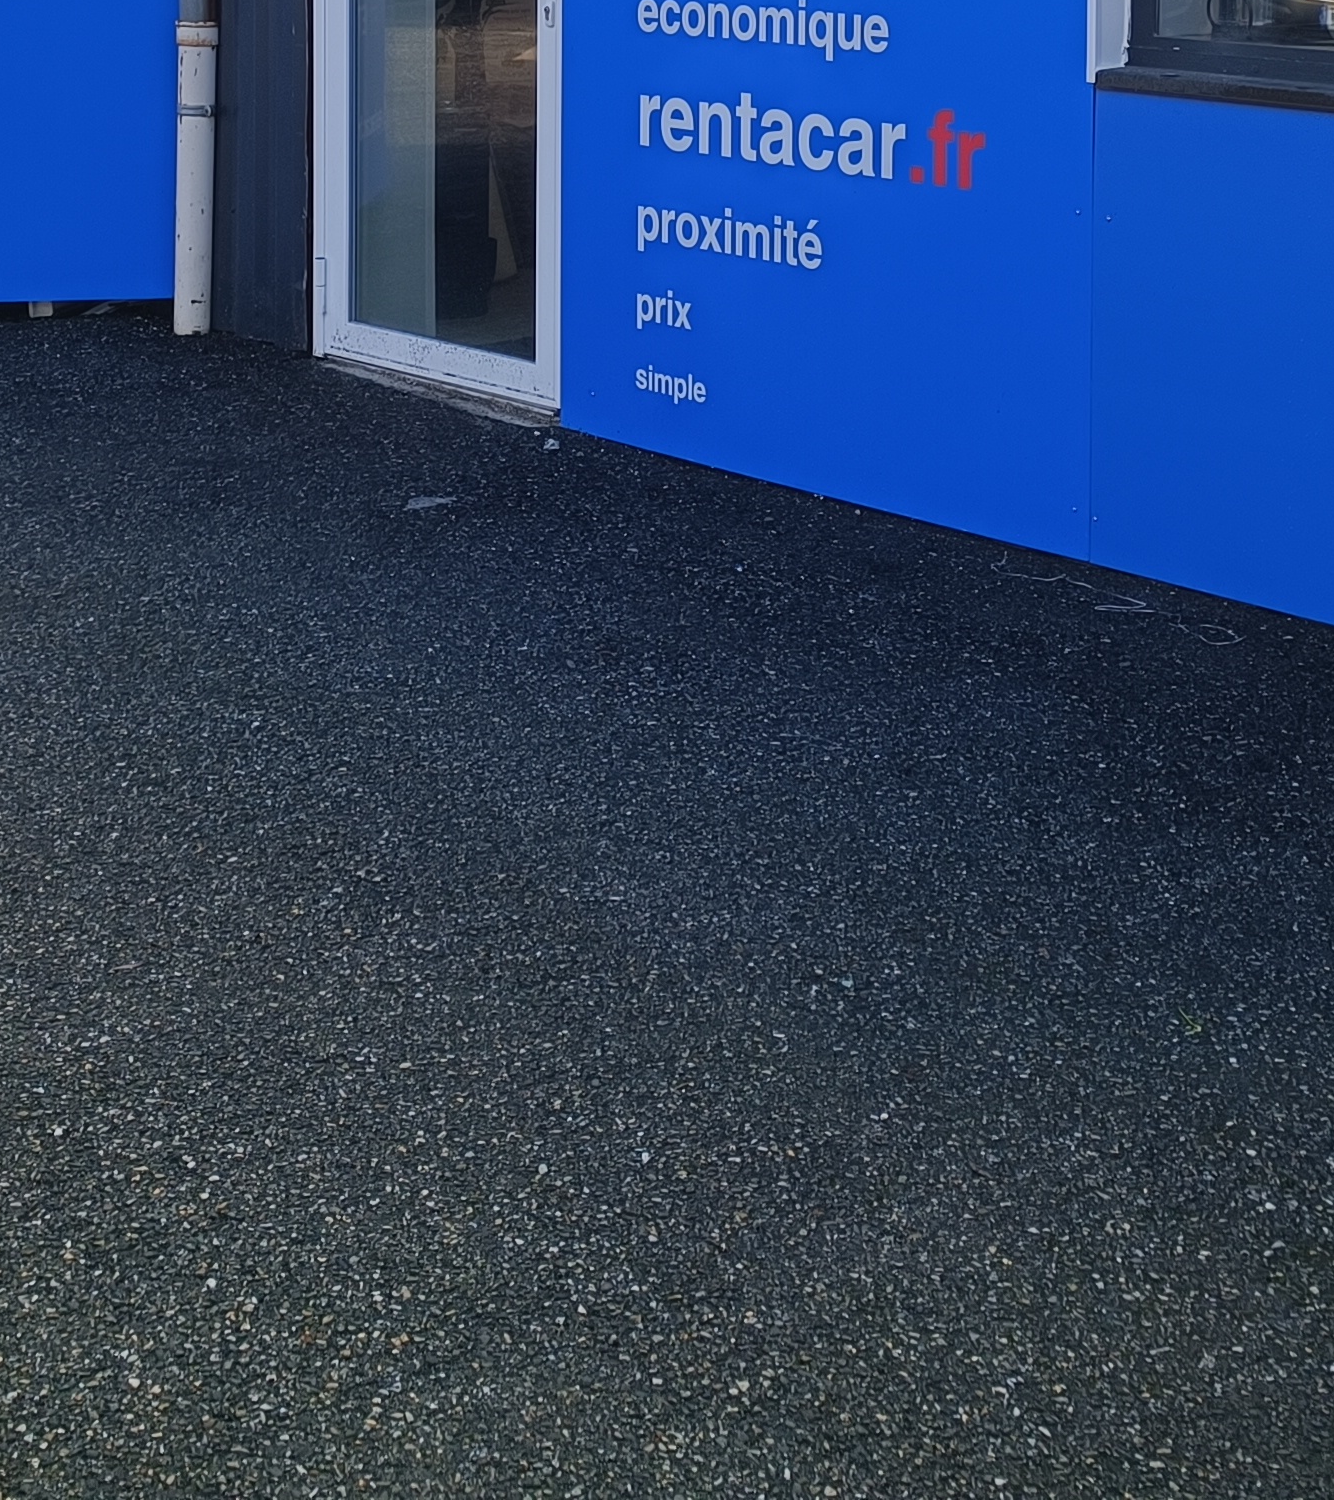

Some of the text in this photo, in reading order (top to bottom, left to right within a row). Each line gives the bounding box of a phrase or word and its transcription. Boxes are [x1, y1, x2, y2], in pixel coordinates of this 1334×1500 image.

[639, 91, 986, 191] rentacar.fr
[637, 205, 823, 270] proximité
[636, 289, 692, 330] prix
[635, 364, 707, 405] simple
